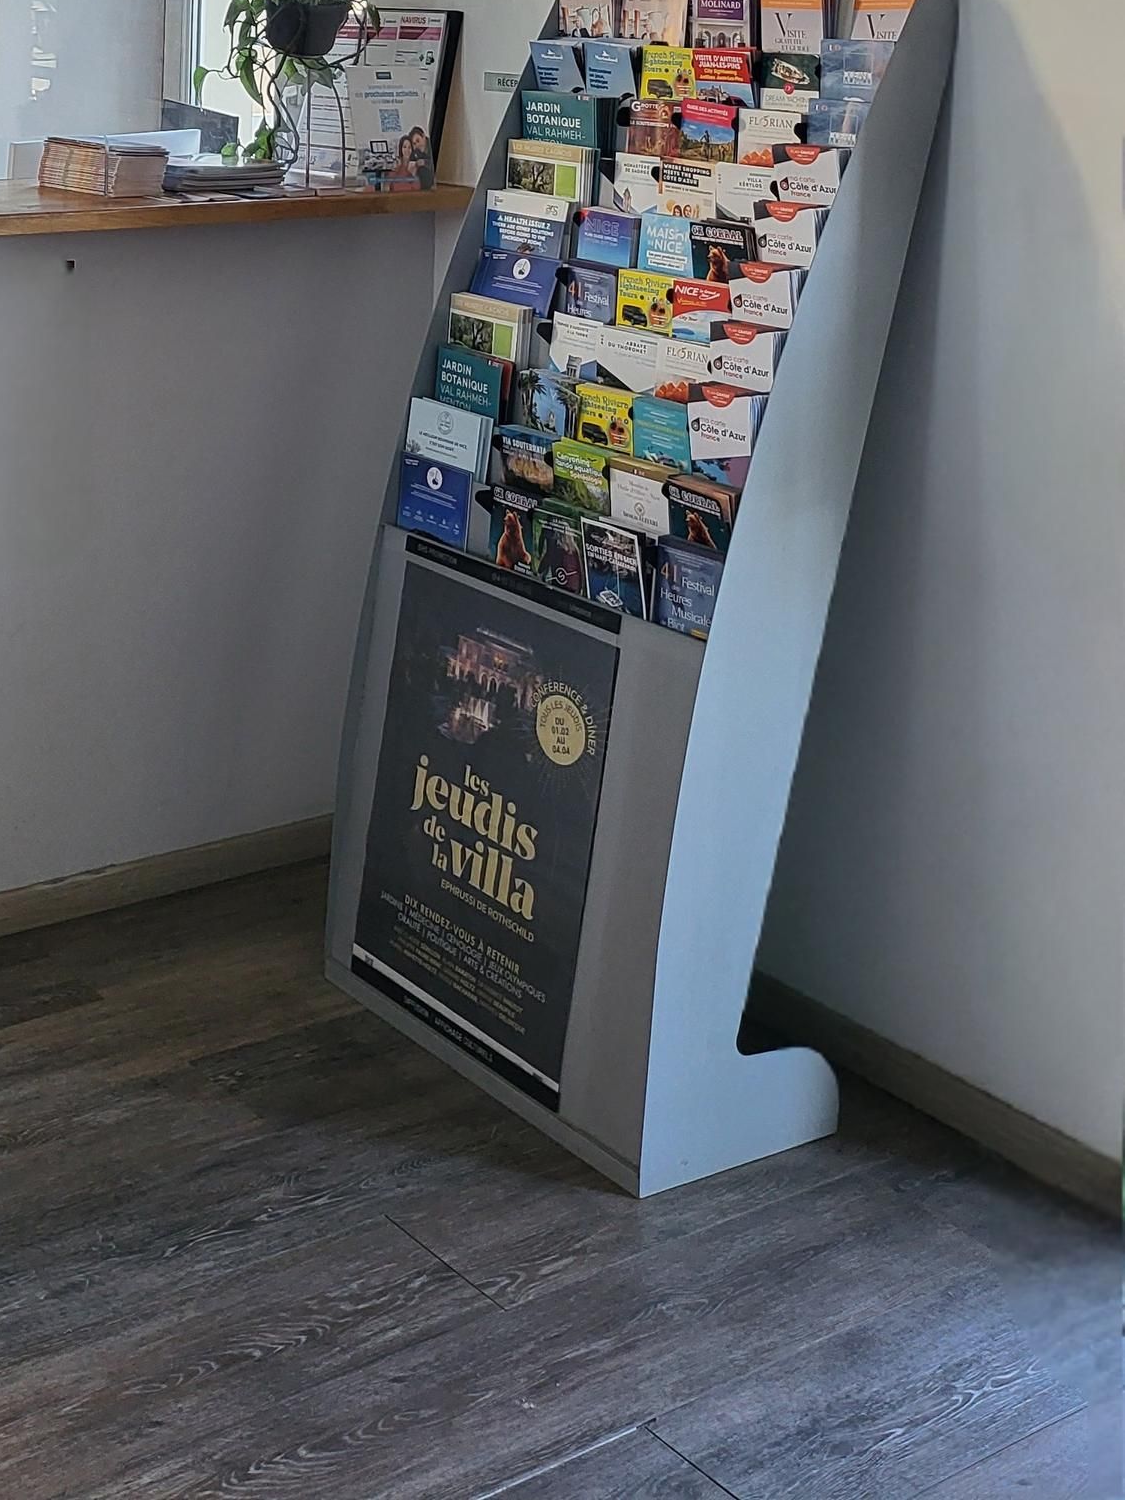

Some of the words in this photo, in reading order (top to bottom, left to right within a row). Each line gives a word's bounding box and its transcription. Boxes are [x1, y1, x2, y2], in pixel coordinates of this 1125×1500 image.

[700, 0, 741, 10] MOLINARD
[775, 12, 807, 39] VISITE
[867, 14, 898, 39] VISITE
[526, 101, 561, 114] JARDIN
[527, 114, 581, 129] BOTANIQUE
[527, 125, 544, 137] VAL
[545, 127, 586, 141] RAHMEH-
[663, 163, 682, 171] WHERE
[682, 166, 710, 176] SHOPPING
[663, 169, 681, 177] MEETS
[789, 182, 810, 191] Côte
[811, 184, 837, 194] d'Azur
[504, 215, 528, 226] HEALTH
[584, 218, 620, 237] NICE
[646, 225, 691, 242] MAISON
[706, 226, 744, 241] CORRAL
[654, 238, 684, 254] NICE
[767, 240, 786, 250] Côte
[788, 242, 812, 253] d'Azur
[767, 249, 787, 257] France
[568, 282, 583, 298] 41
[674, 284, 700, 297] NICE
[584, 291, 610, 306] Festival
[567, 303, 592, 318] Heures
[743, 301, 762, 310] Côte
[763, 302, 788, 315] d'Azur
[626, 341, 647, 350] ABBAYE
[441, 358, 472, 376] JARDIN
[723, 361, 743, 373] Côte
[744, 365, 770, 378] d'Azur
[723, 370, 743, 380] France
[441, 371, 489, 394] BOTANIQUE
[440, 383, 455, 396] VAL
[456, 389, 492, 408] RAHMEH-
[700, 422, 720, 436] Côte
[721, 427, 746, 442] d'Azur
[700, 432, 721, 443] France
[502, 436, 512, 446] VIA
[556, 451, 590, 468] Canyoning
[585, 542, 613, 557] SORTIES
[660, 562, 677, 582] 41
[681, 576, 715, 597] Festival
[660, 587, 692, 607] Heures
[667, 617, 685, 632] Biot
[530, 681, 583, 708] CONFÉRENCE
[580, 704, 588, 715] &
[584, 715, 597, 756] DÎNER
[539, 704, 552, 728] TOUS
[550, 700, 564, 710] LES
[563, 703, 582, 732] JEUDIS
[554, 717, 565, 726] DU
[555, 736, 566, 745] AU
[464, 764, 491, 797] les
[410, 754, 539, 861] jeudis
[423, 815, 446, 843] de
[431, 843, 448, 872] la
[449, 838, 535, 921] villa
[440, 878, 475, 906] EPHRUSSI
[476, 899, 488, 916] DE
[488, 906, 535, 943] ROTHSCHILD
[404, 893, 418, 910] DIX
[419, 902, 475, 947] RENDEZ-VOUS
[485, 944, 521, 976] RETENIR
[462, 953, 478, 971] ARTS
[484, 966, 523, 1000] CRÉATIONS
[487, 959, 503, 977] JEUX
[503, 969, 546, 1004] OLYMPIQUES
